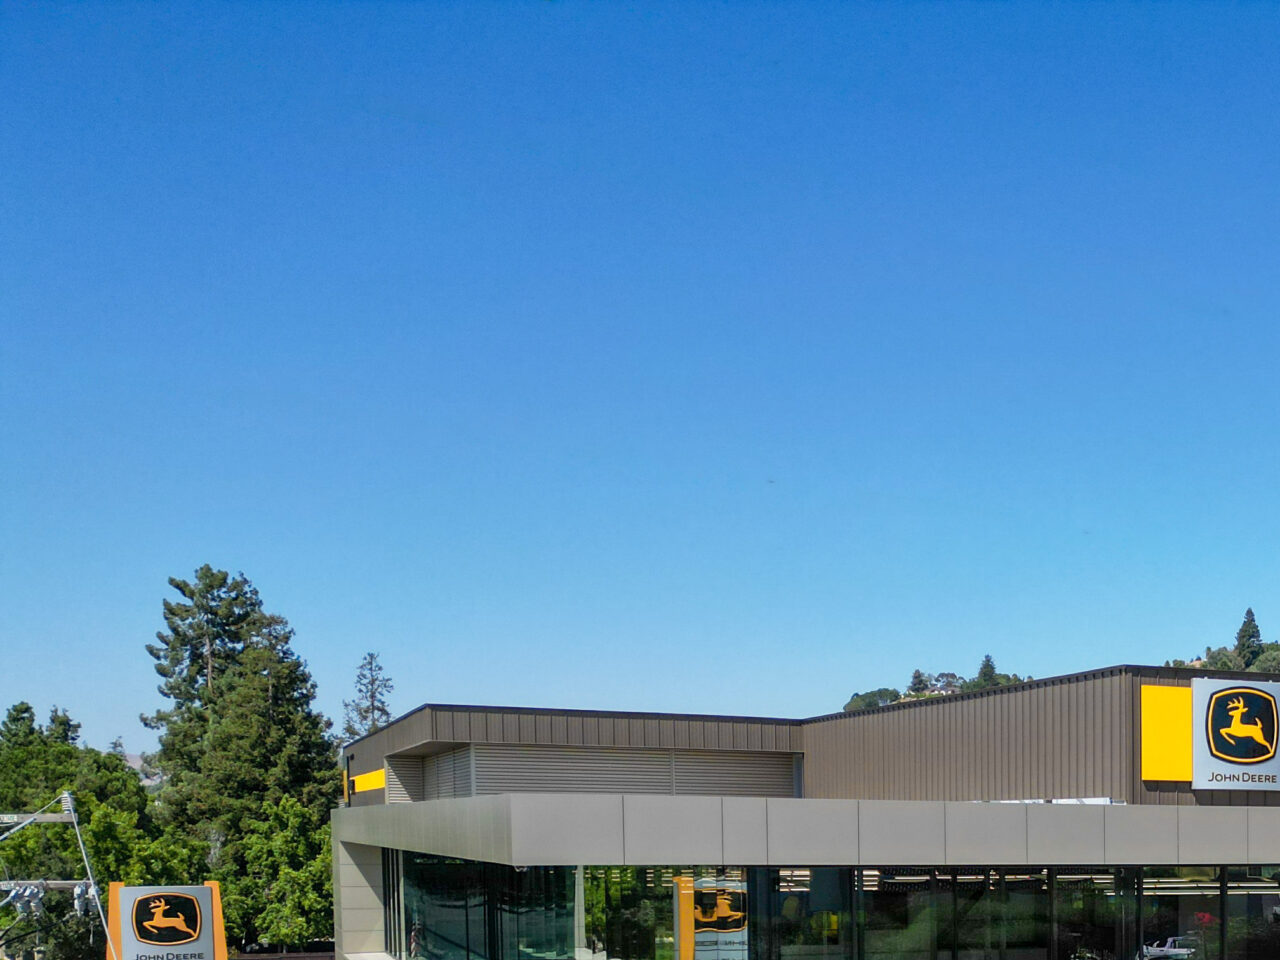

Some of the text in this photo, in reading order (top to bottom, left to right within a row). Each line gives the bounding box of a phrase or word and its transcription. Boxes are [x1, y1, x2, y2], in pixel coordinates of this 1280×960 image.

[1208, 772, 1278, 783] JOHN DEERE
[166, 952, 205, 960] DEERE
